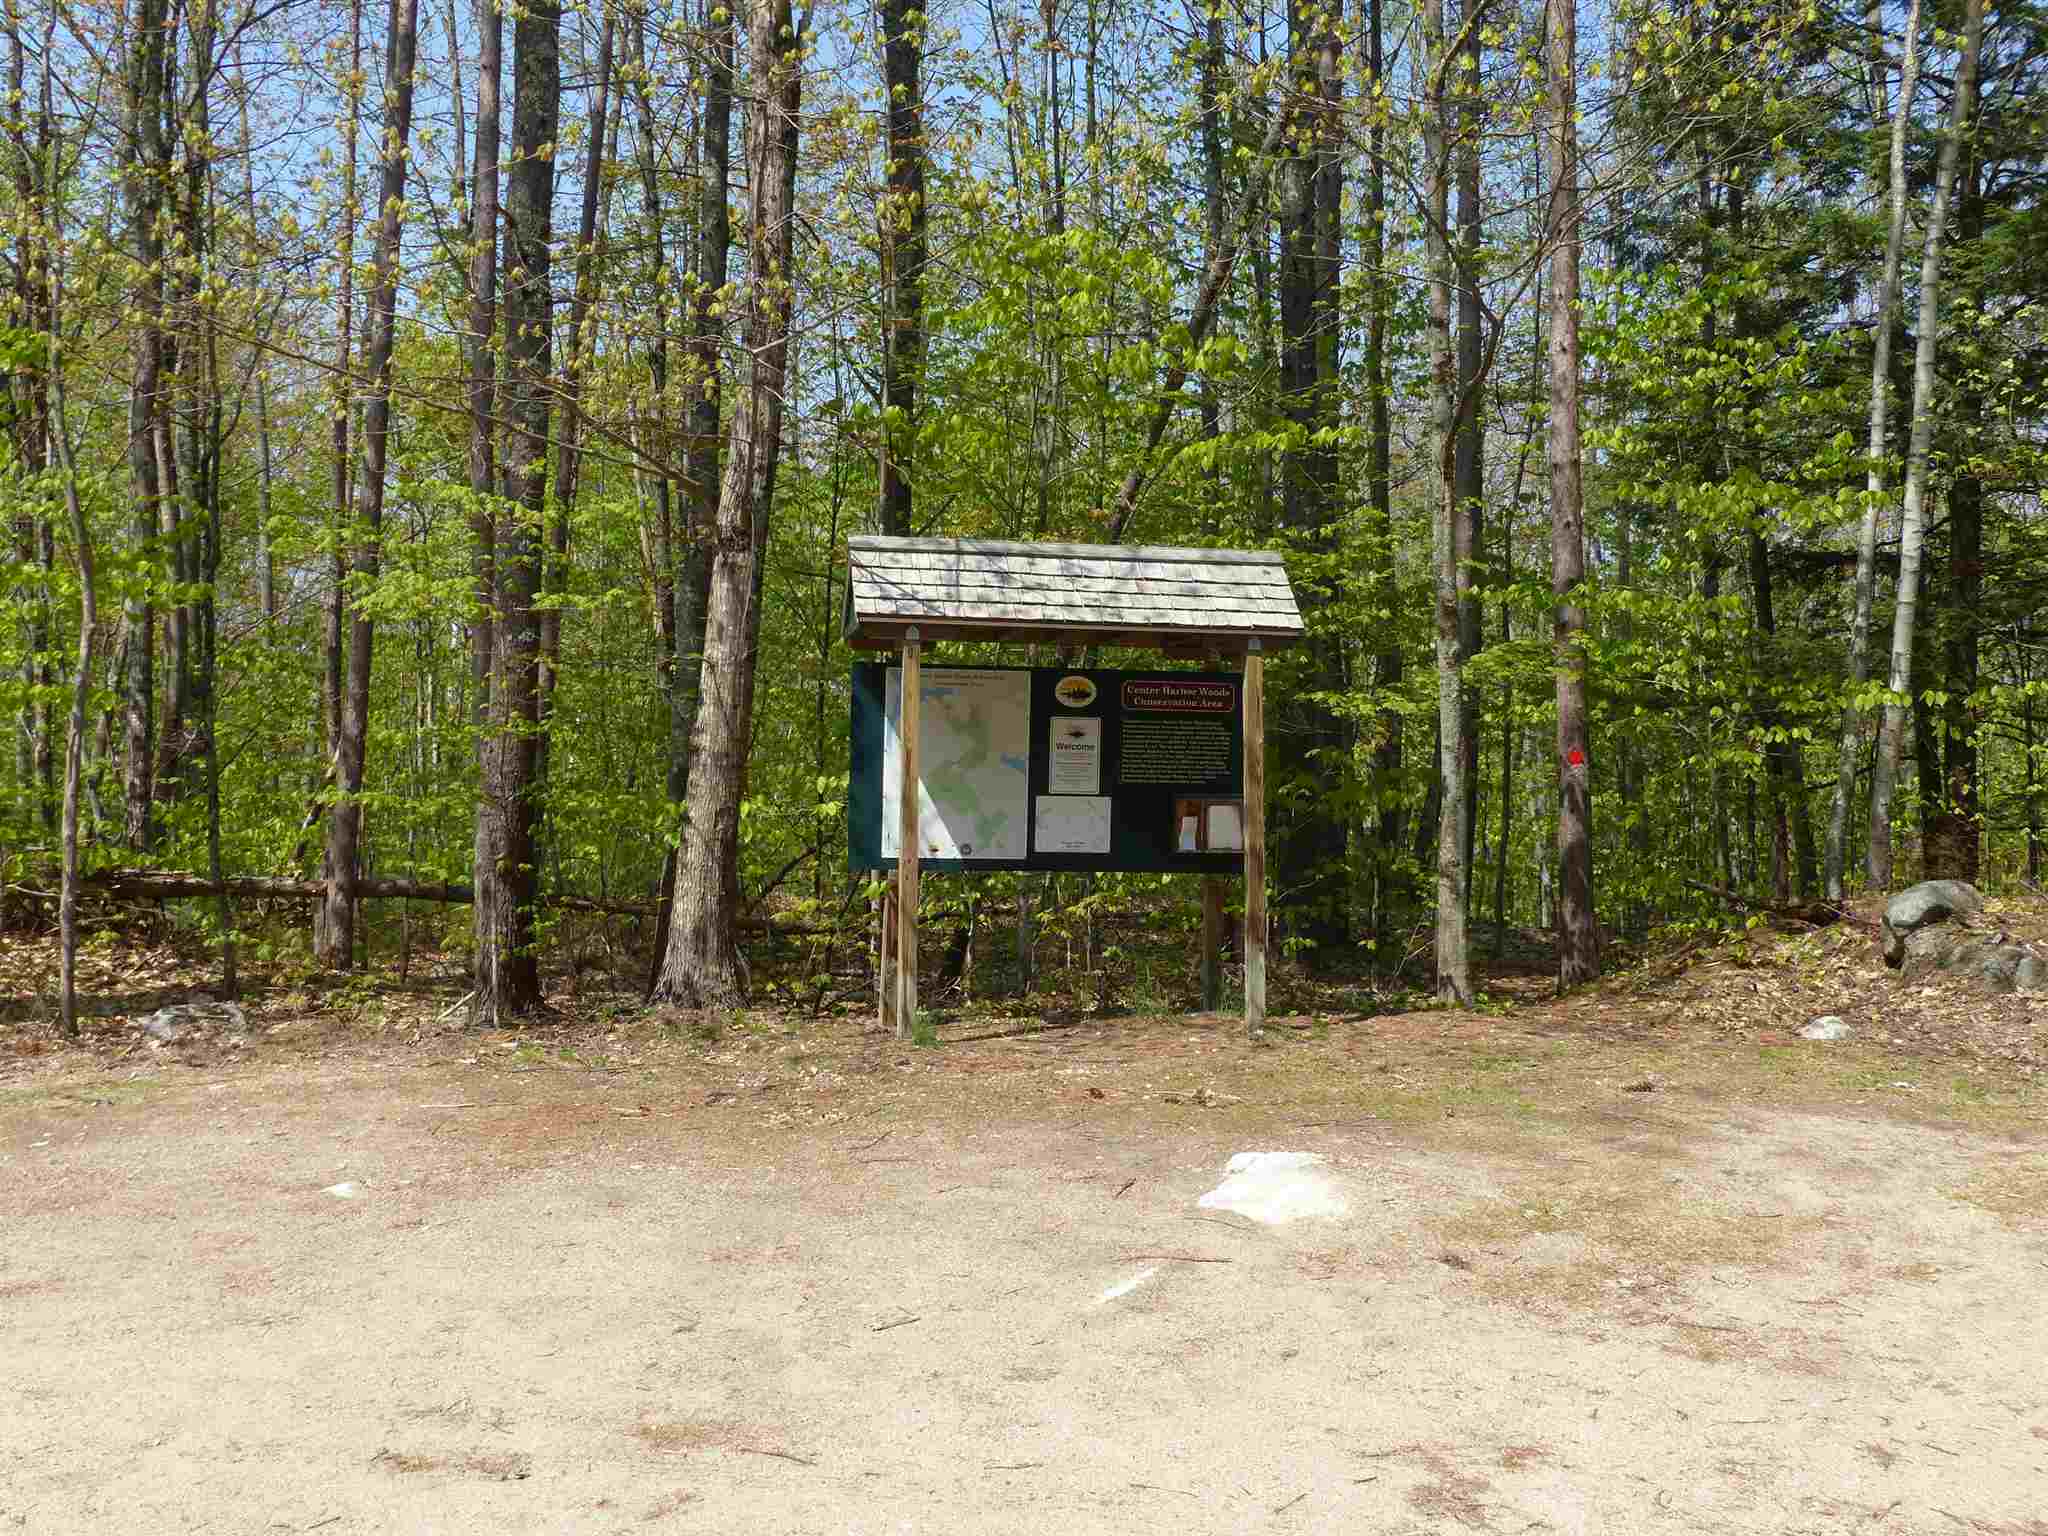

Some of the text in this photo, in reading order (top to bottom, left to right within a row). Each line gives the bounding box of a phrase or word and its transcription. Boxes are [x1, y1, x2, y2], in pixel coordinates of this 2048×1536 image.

[1127, 686, 1161, 697] Center
[1199, 687, 1231, 698] Woods
[1134, 696, 1224, 707] Conservation Area
[1056, 742, 1096, 752] Welcome
